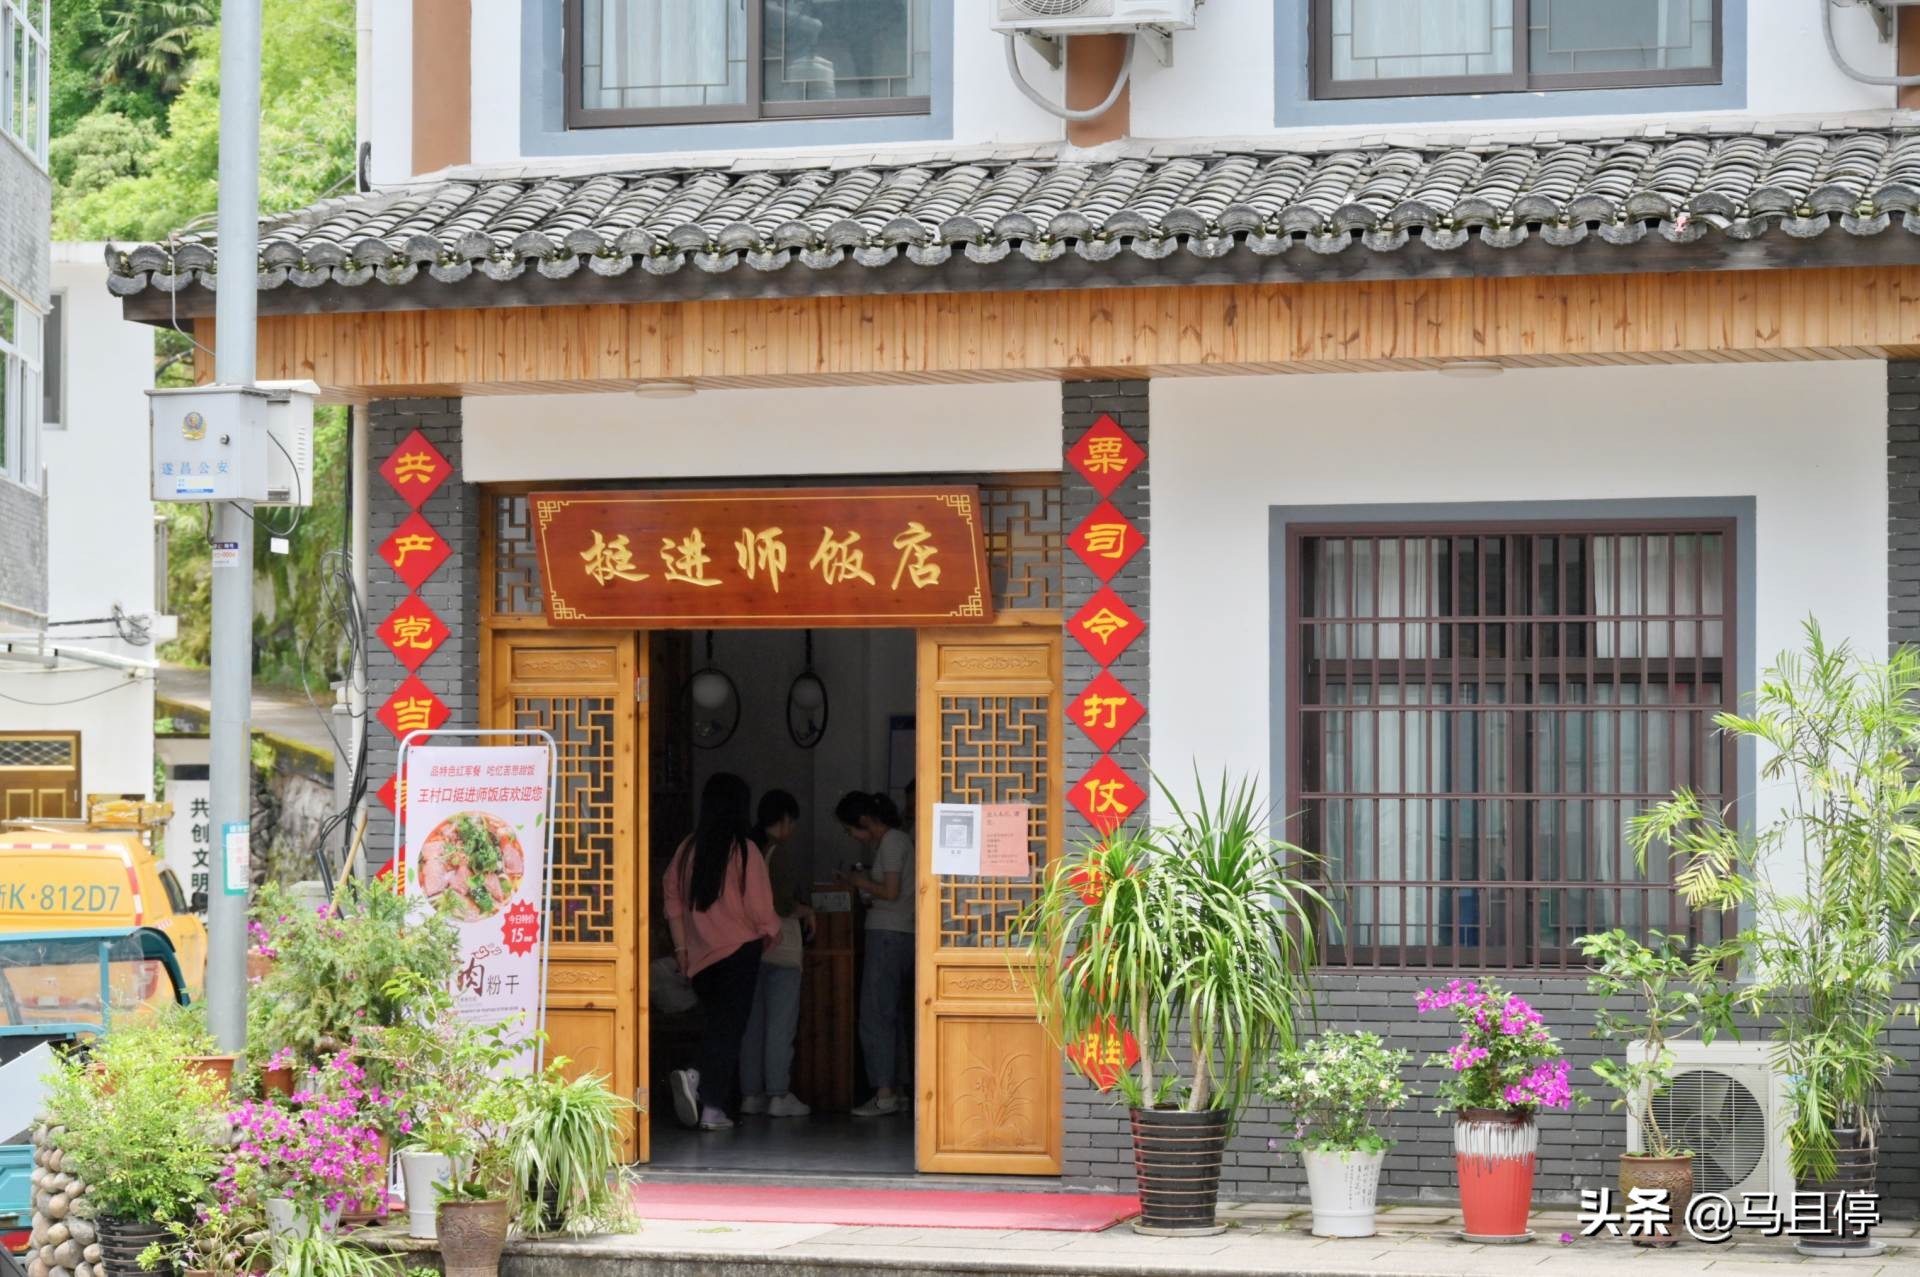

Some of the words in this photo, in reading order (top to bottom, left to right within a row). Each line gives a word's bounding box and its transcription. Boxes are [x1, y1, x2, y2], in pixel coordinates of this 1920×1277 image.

[579, 521, 940, 592] 挺进师饭店
[417, 785, 543, 803] 王村口挺进师饭店欢迎您
[511, 927, 524, 942] 15
